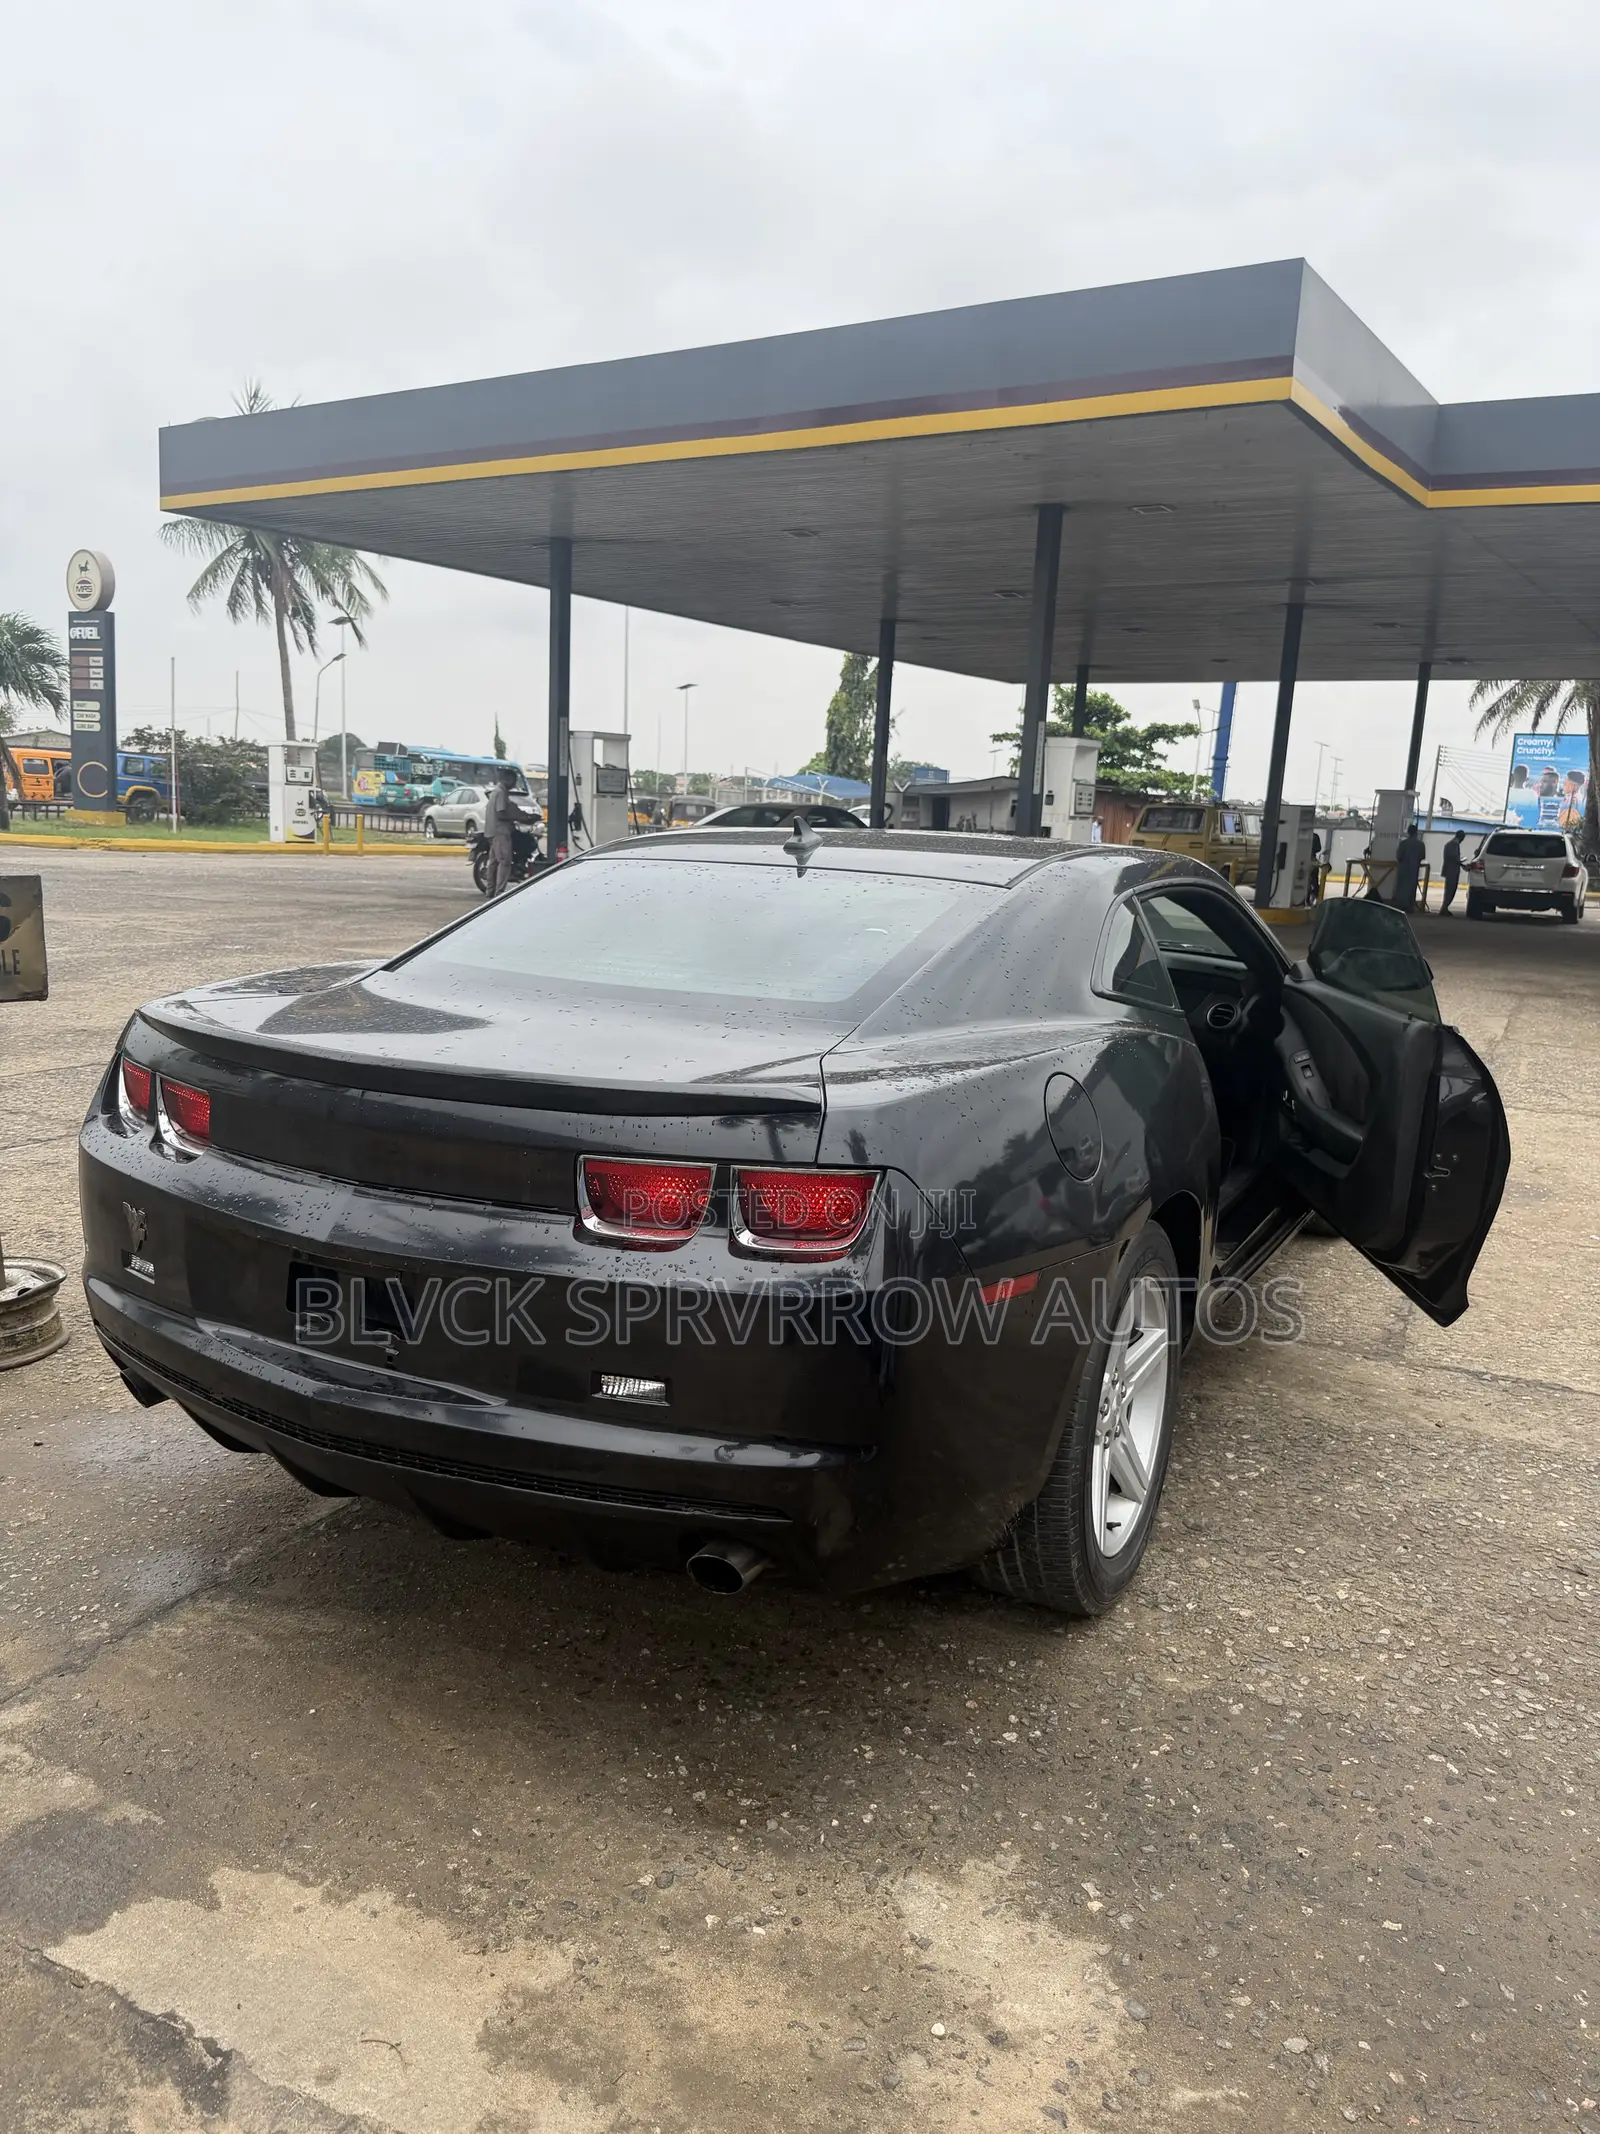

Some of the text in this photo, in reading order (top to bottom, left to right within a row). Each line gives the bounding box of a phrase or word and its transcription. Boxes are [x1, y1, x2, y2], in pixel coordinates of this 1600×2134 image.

[1517, 738, 1554, 748] Creamy.
[1516, 746, 1556, 756] Crunchy.
[0, 949, 21, 976] LE
